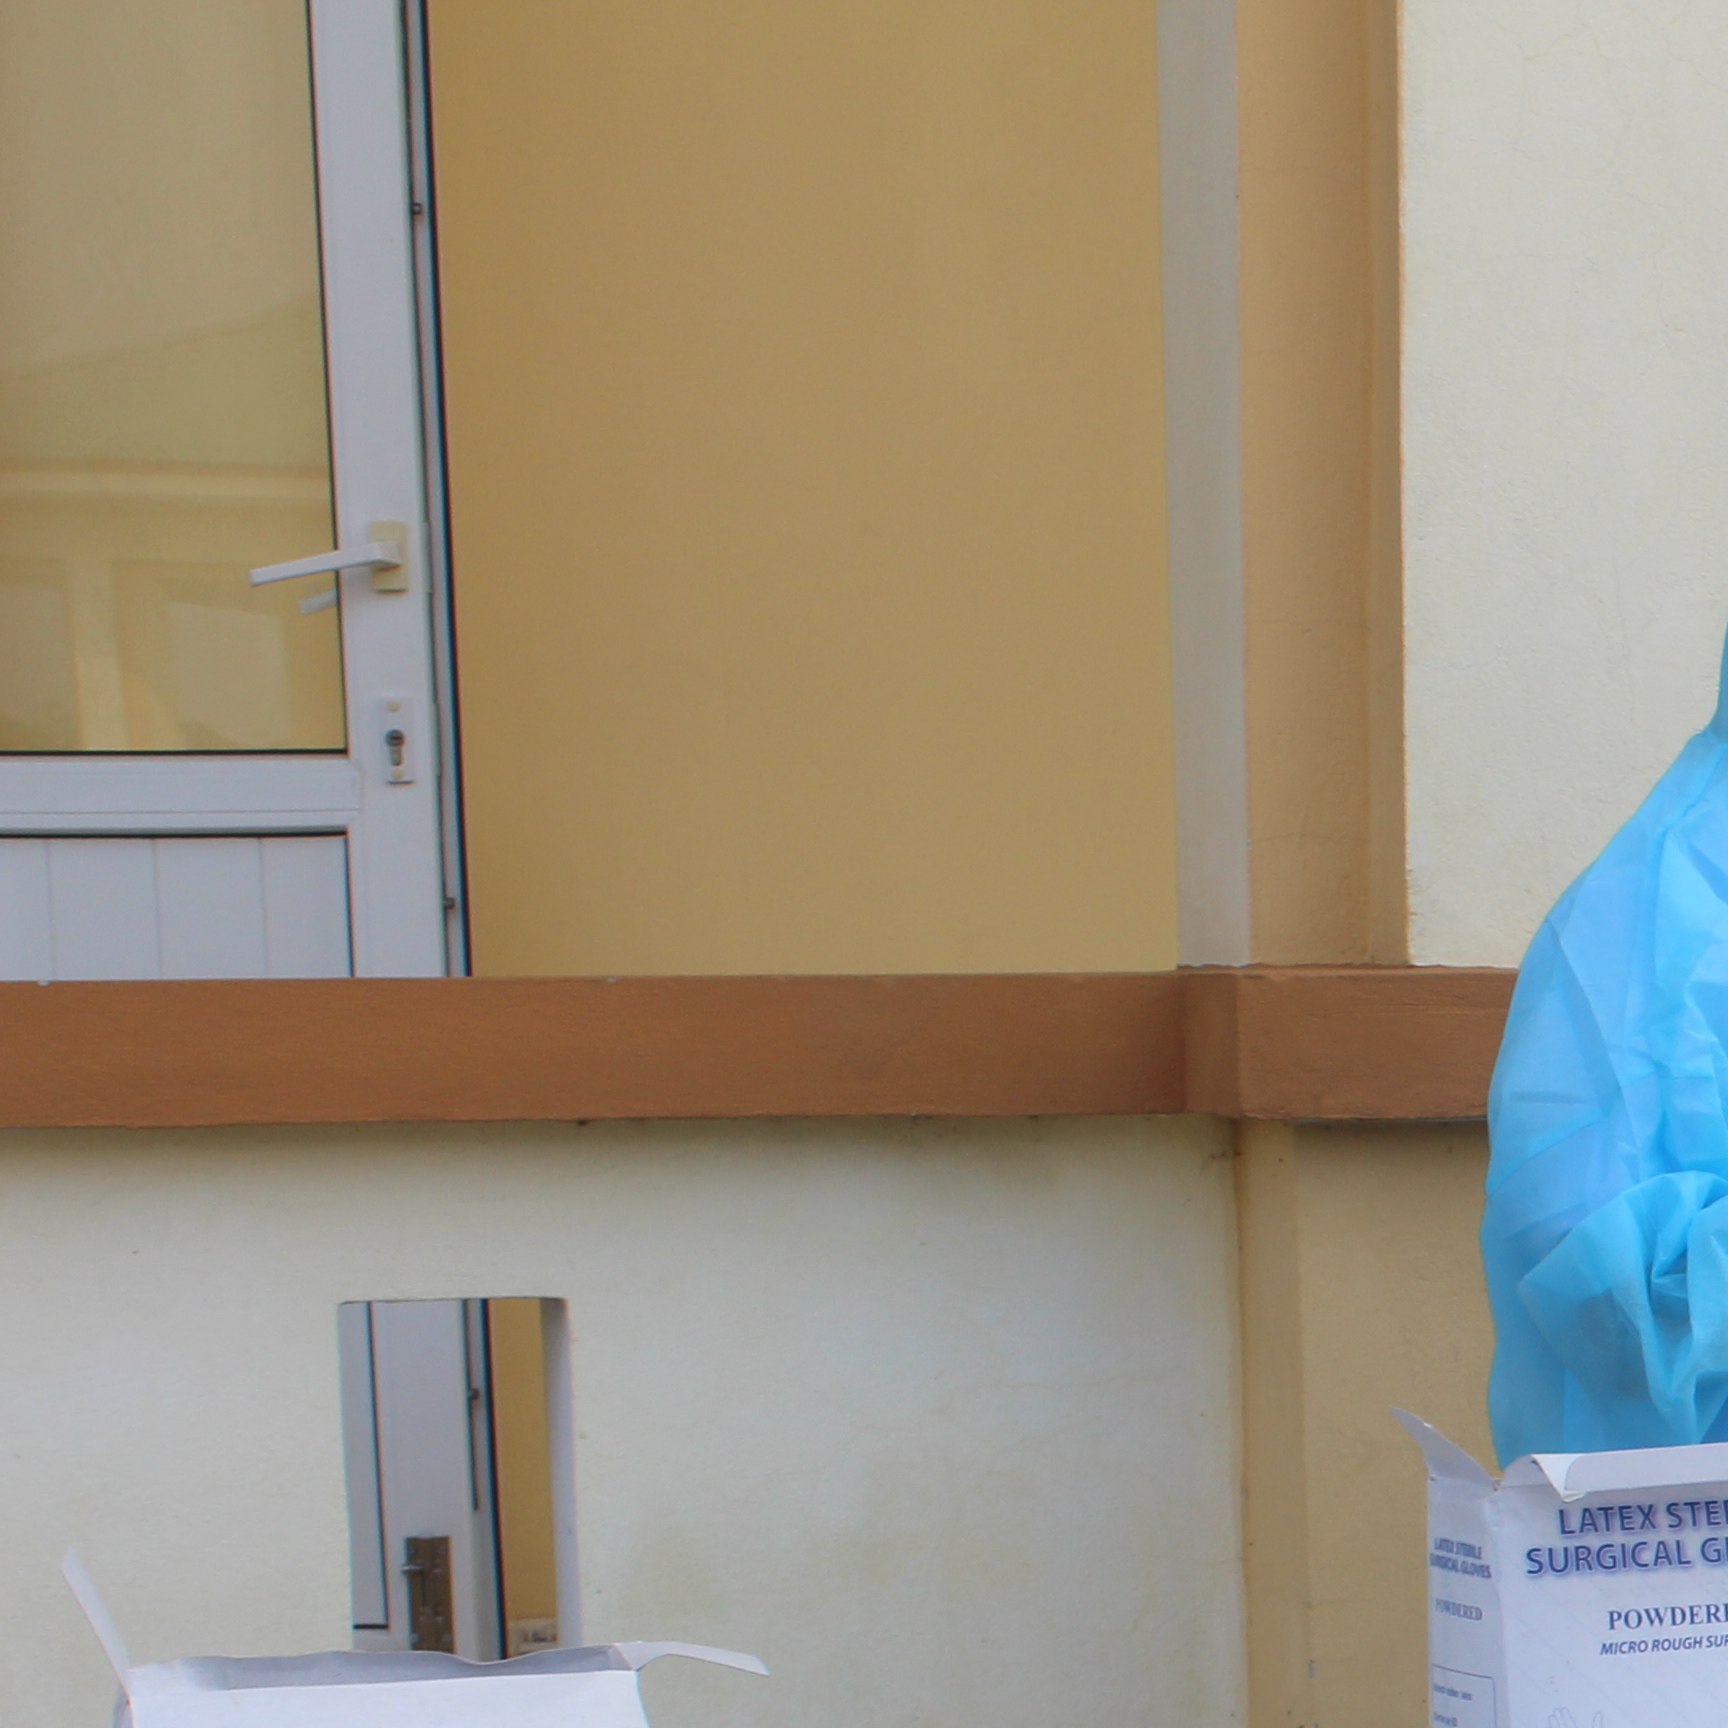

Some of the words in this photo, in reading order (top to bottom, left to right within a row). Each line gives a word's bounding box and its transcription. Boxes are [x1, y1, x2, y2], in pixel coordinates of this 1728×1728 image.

[1558, 1504, 1656, 1535] LATEX
[1526, 1540, 1691, 1575] SURGICAL
[1600, 1640, 1648, 1655] MICRO
[1652, 1636, 1702, 1653] ROUGH
